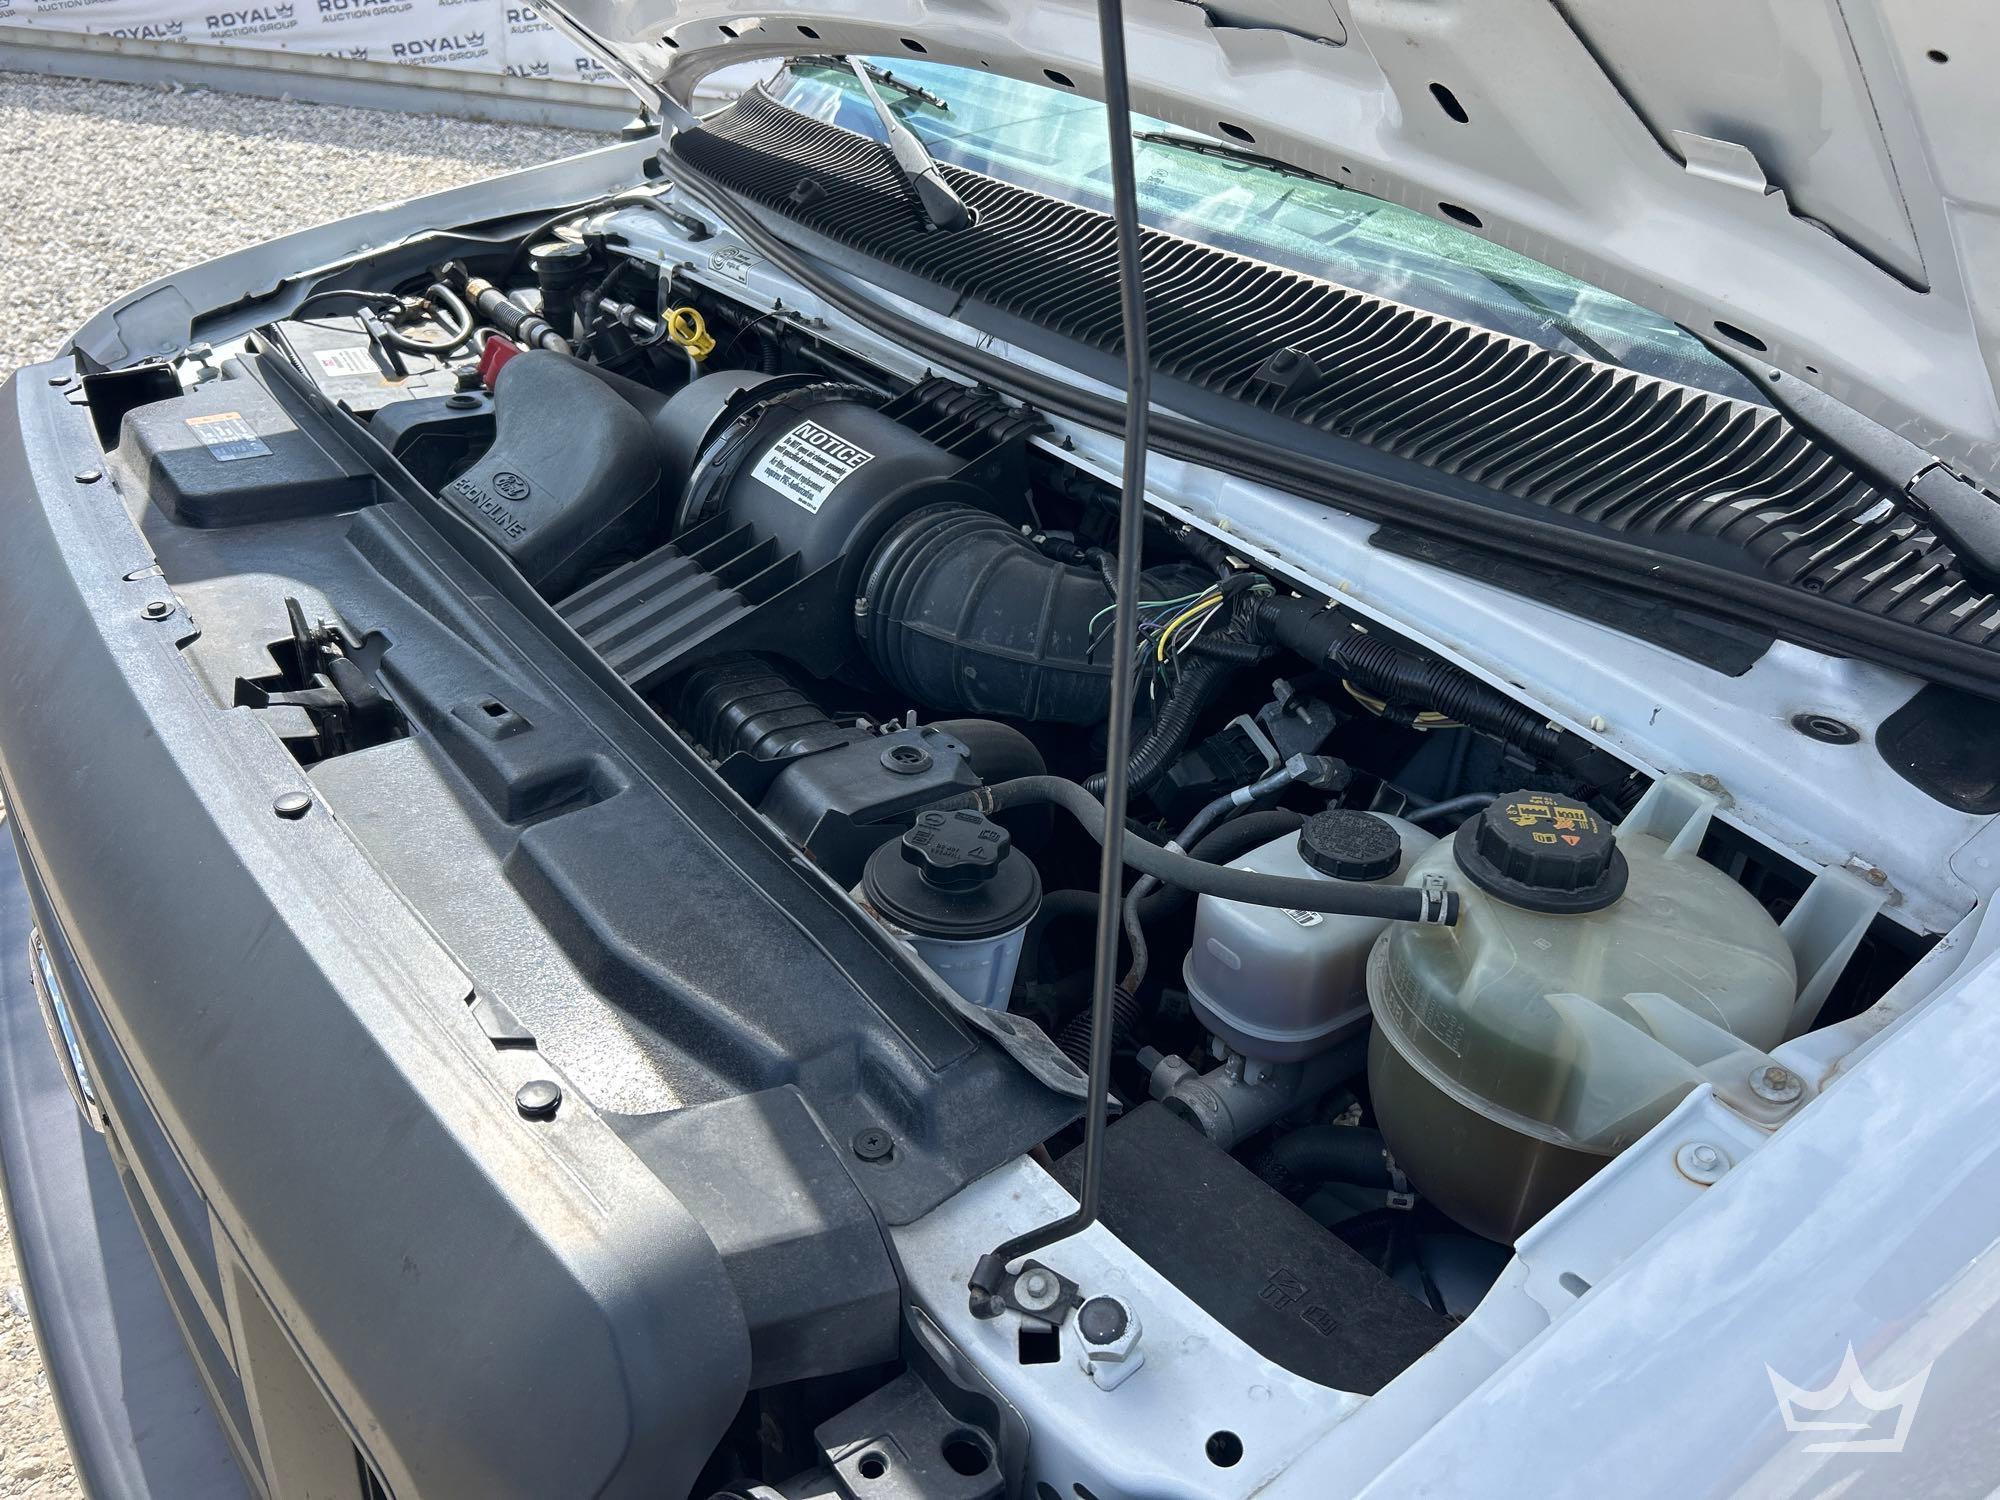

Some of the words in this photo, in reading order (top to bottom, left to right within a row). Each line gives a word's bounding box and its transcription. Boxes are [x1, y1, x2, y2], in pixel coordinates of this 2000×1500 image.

[206, 7, 276, 29] ROYAL
[322, 9, 371, 23] AUCTION
[372, 3, 413, 16] GROUP
[98, 24, 166, 40] OYAL
[210, 26, 257, 39] AUCTION
[258, 19, 298, 33] GROUP
[391, 35, 466, 57] ROYAL
[449, 49, 489, 62] GROUP
[796, 424, 867, 467] NOTICE
[454, 479, 527, 538] ECONOLINE
